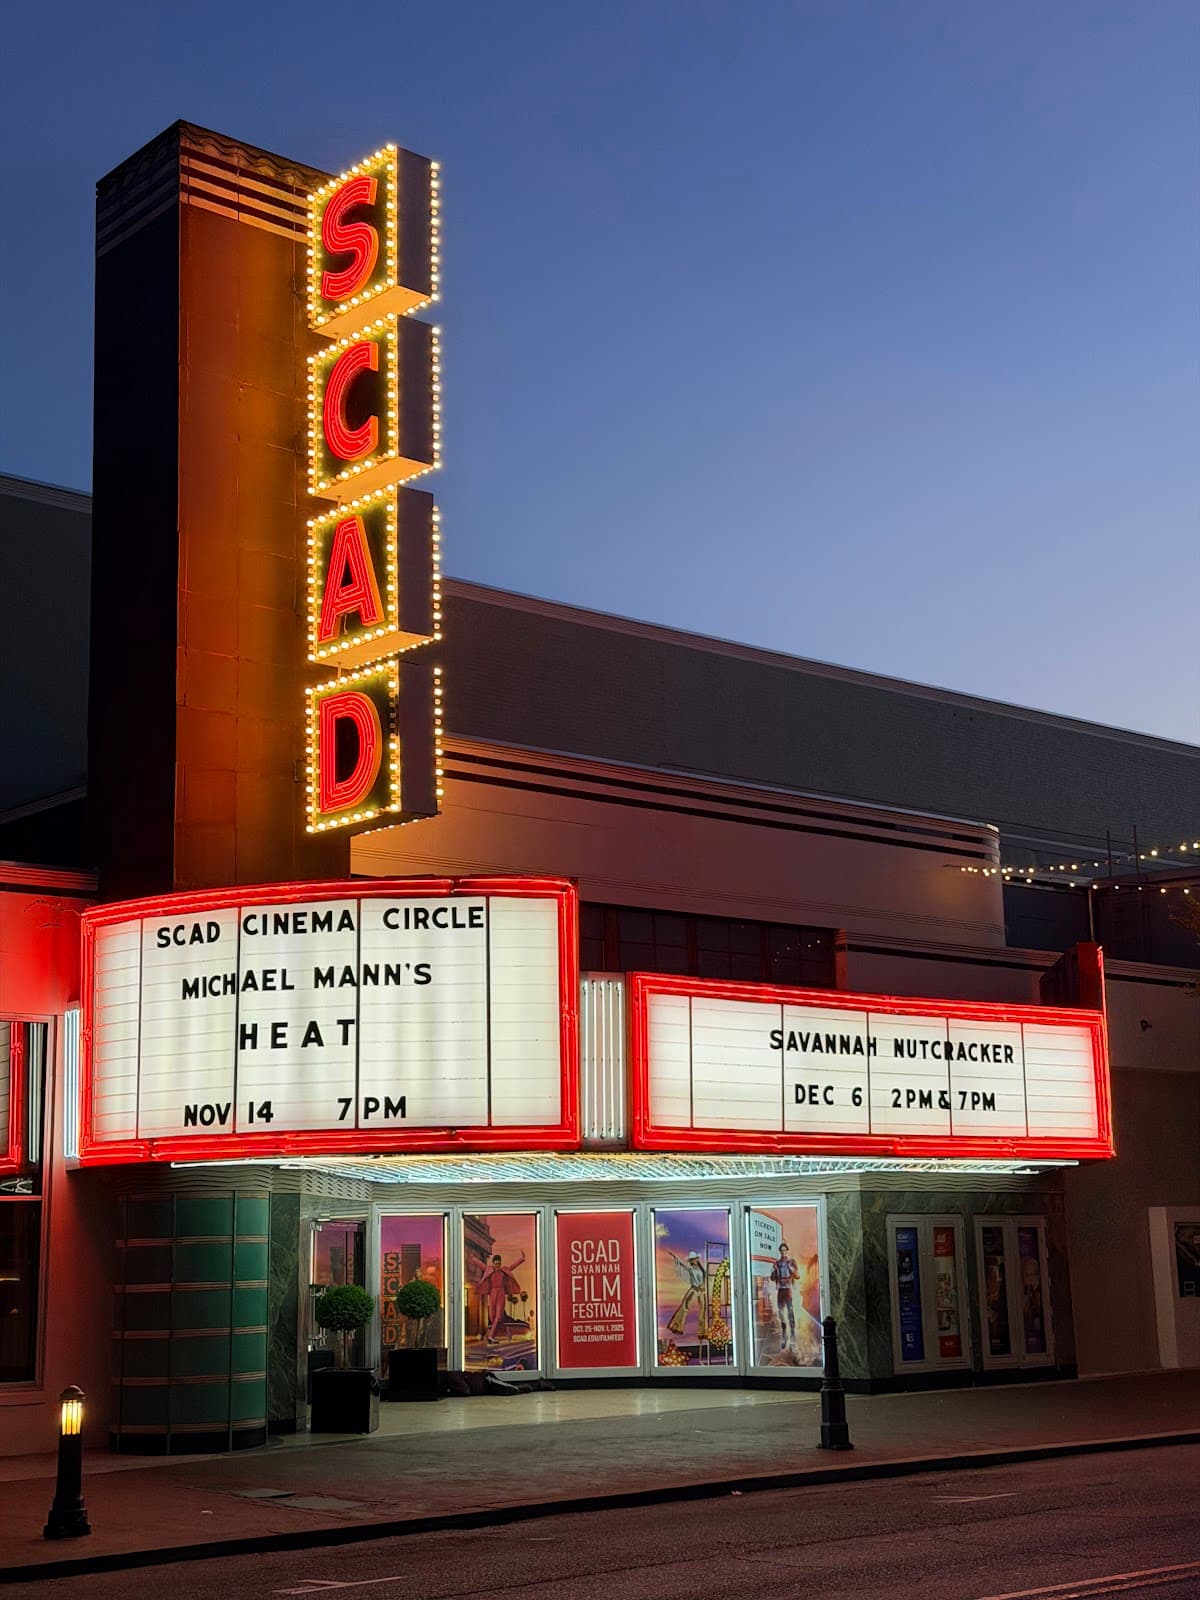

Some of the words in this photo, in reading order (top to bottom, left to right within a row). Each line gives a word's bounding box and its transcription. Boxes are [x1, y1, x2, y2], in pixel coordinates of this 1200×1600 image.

[320, 174, 386, 814] SCAD
[156, 921, 221, 948] SCAD
[242, 909, 355, 936] CINEMA
[382, 906, 484, 930] CIRCLE
[181, 967, 295, 1000] MICHAEL
[313, 962, 432, 989] MANN'S
[239, 1019, 355, 1050] HEAT
[770, 1029, 877, 1057] SAVANNAH
[894, 1037, 1014, 1064] NUTCRACKER
[795, 1083, 834, 1105] DEC
[851, 1087, 862, 1107] 6
[958, 1090, 996, 1111] 7PM
[184, 1102, 232, 1127] NOV
[247, 1101, 274, 1124] 14
[571, 1240, 620, 1263] SCAD
[571, 1264, 620, 1274] SAVANNAH
[571, 1275, 621, 1302] FILM
[572, 1303, 624, 1318] FESTIVAL
